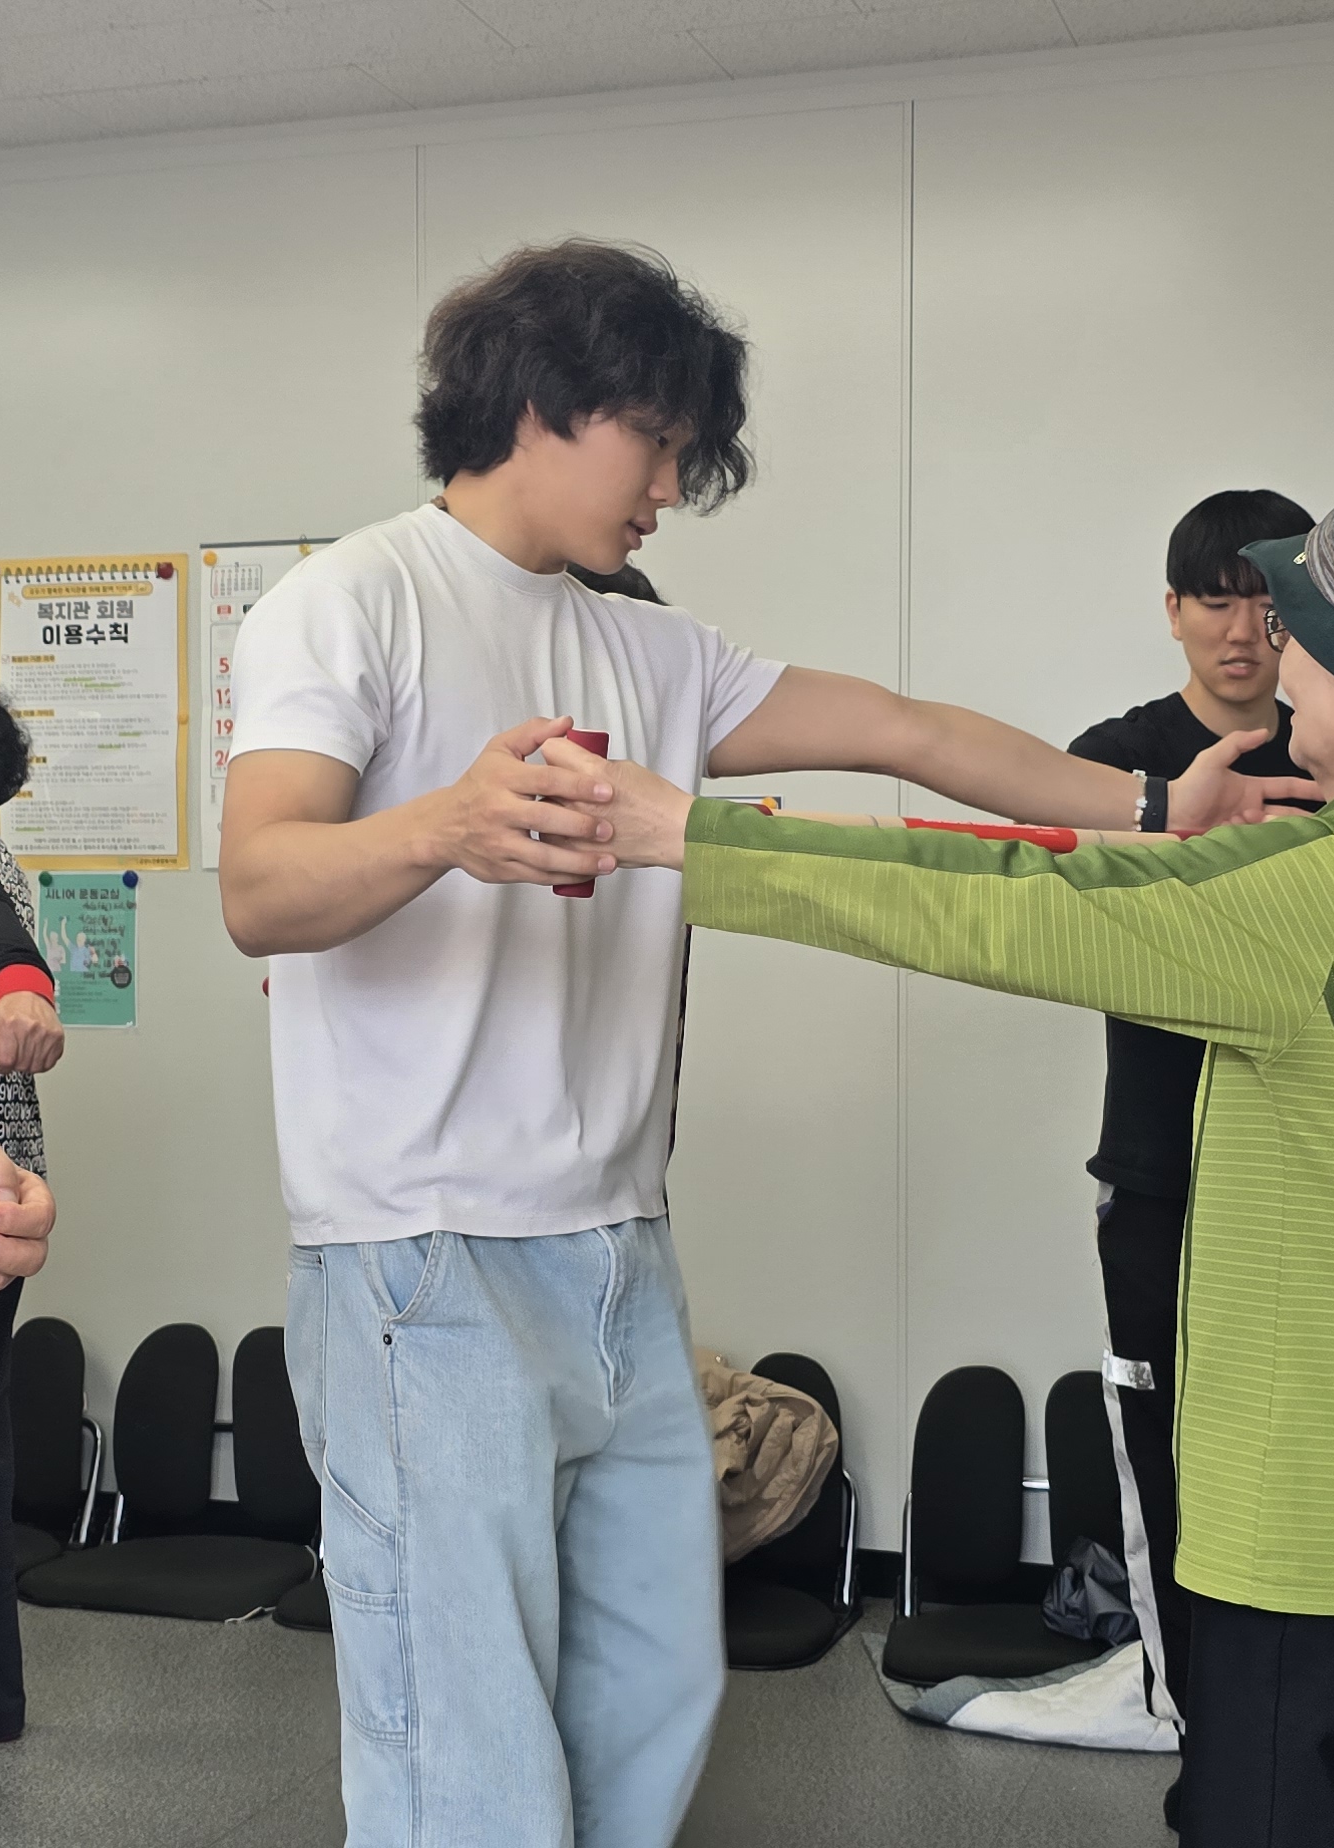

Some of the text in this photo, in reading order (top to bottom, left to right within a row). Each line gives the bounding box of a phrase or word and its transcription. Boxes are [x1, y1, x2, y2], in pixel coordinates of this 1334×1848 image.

[37, 600, 134, 621] 복지관 회원
[42, 623, 129, 645] 이용수칙
[219, 657, 230, 674] 5
[215, 719, 234, 735] 19
[45, 888, 120, 900] 시니어 운동교실
